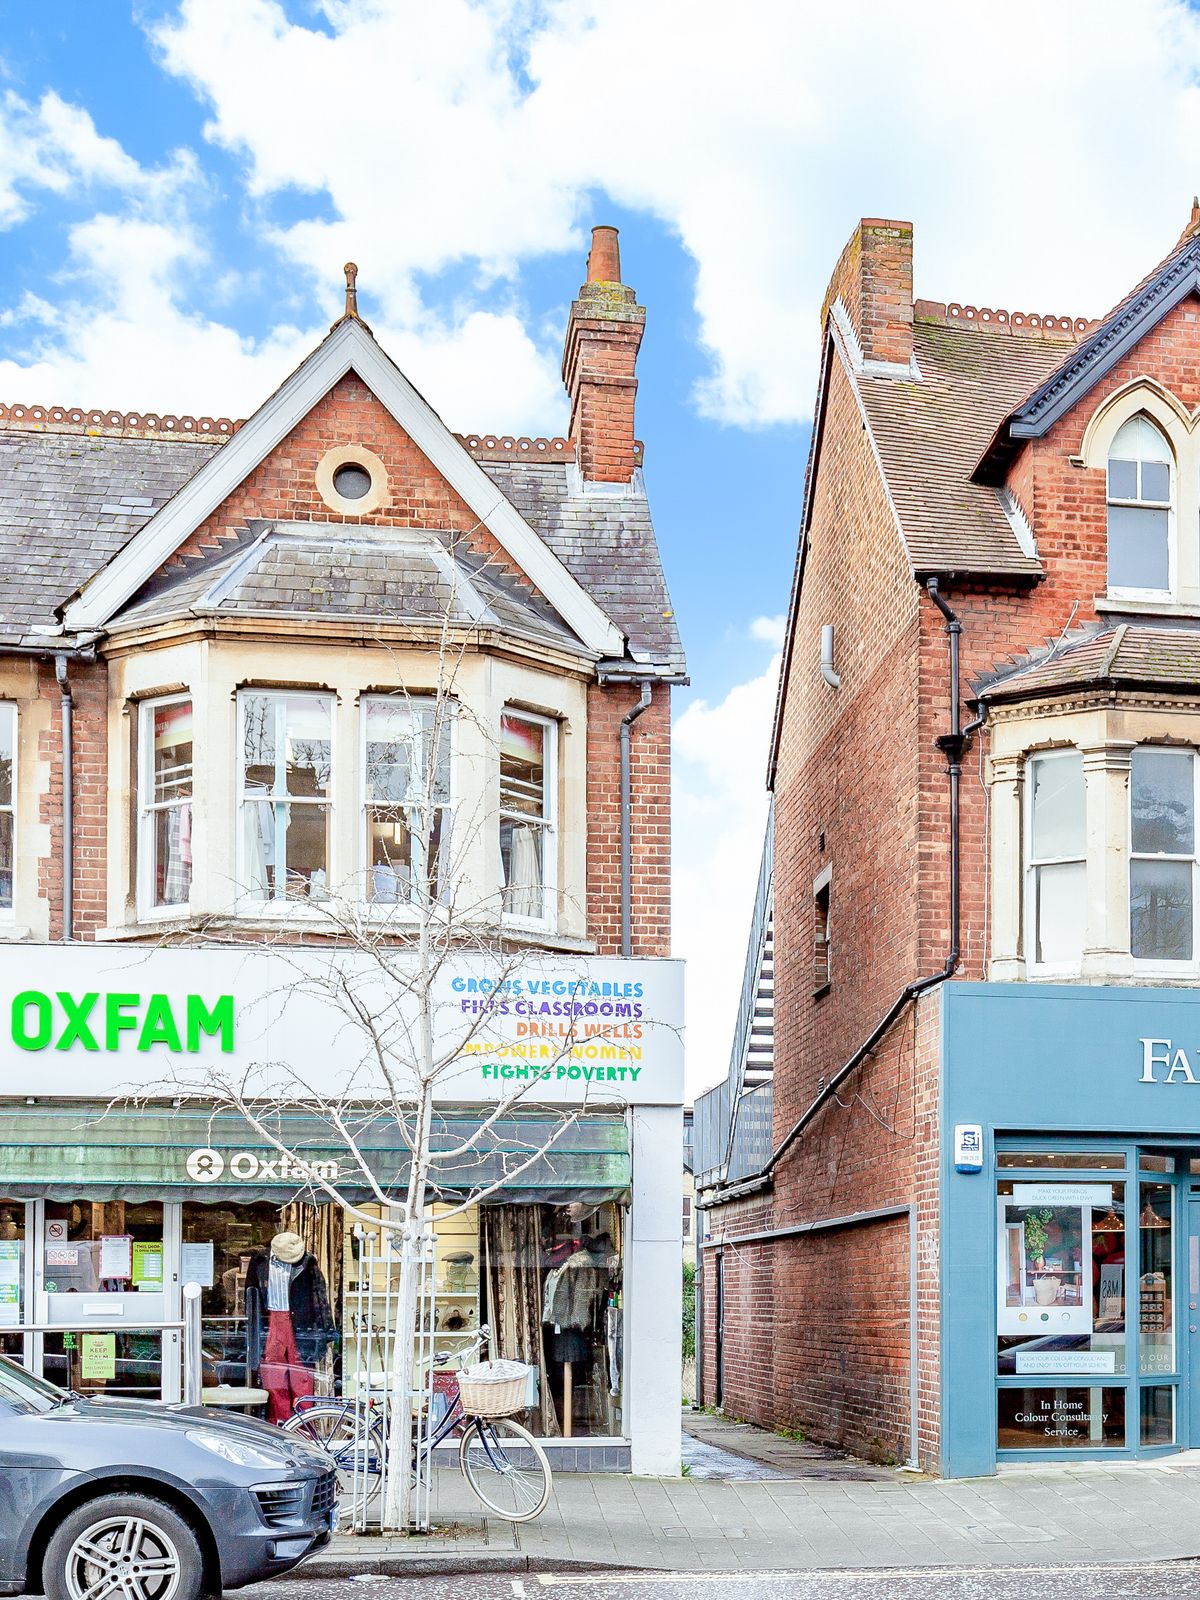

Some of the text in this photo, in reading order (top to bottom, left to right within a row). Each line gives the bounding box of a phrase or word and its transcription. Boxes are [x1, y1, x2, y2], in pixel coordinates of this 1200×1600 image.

[527, 979, 644, 998] VEGETABLES
[515, 1001, 643, 1018] CLASSROOMS
[11, 990, 235, 1053] OXFAM
[516, 1022, 643, 1039] DRILLS WELLS
[556, 1065, 643, 1082] POVERTY
[230, 1152, 338, 1180] Oxfam
[1041, 1400, 1083, 1410] In Home
[1014, 1412, 1049, 1422] Colour
[1044, 1426, 1079, 1437] Service
